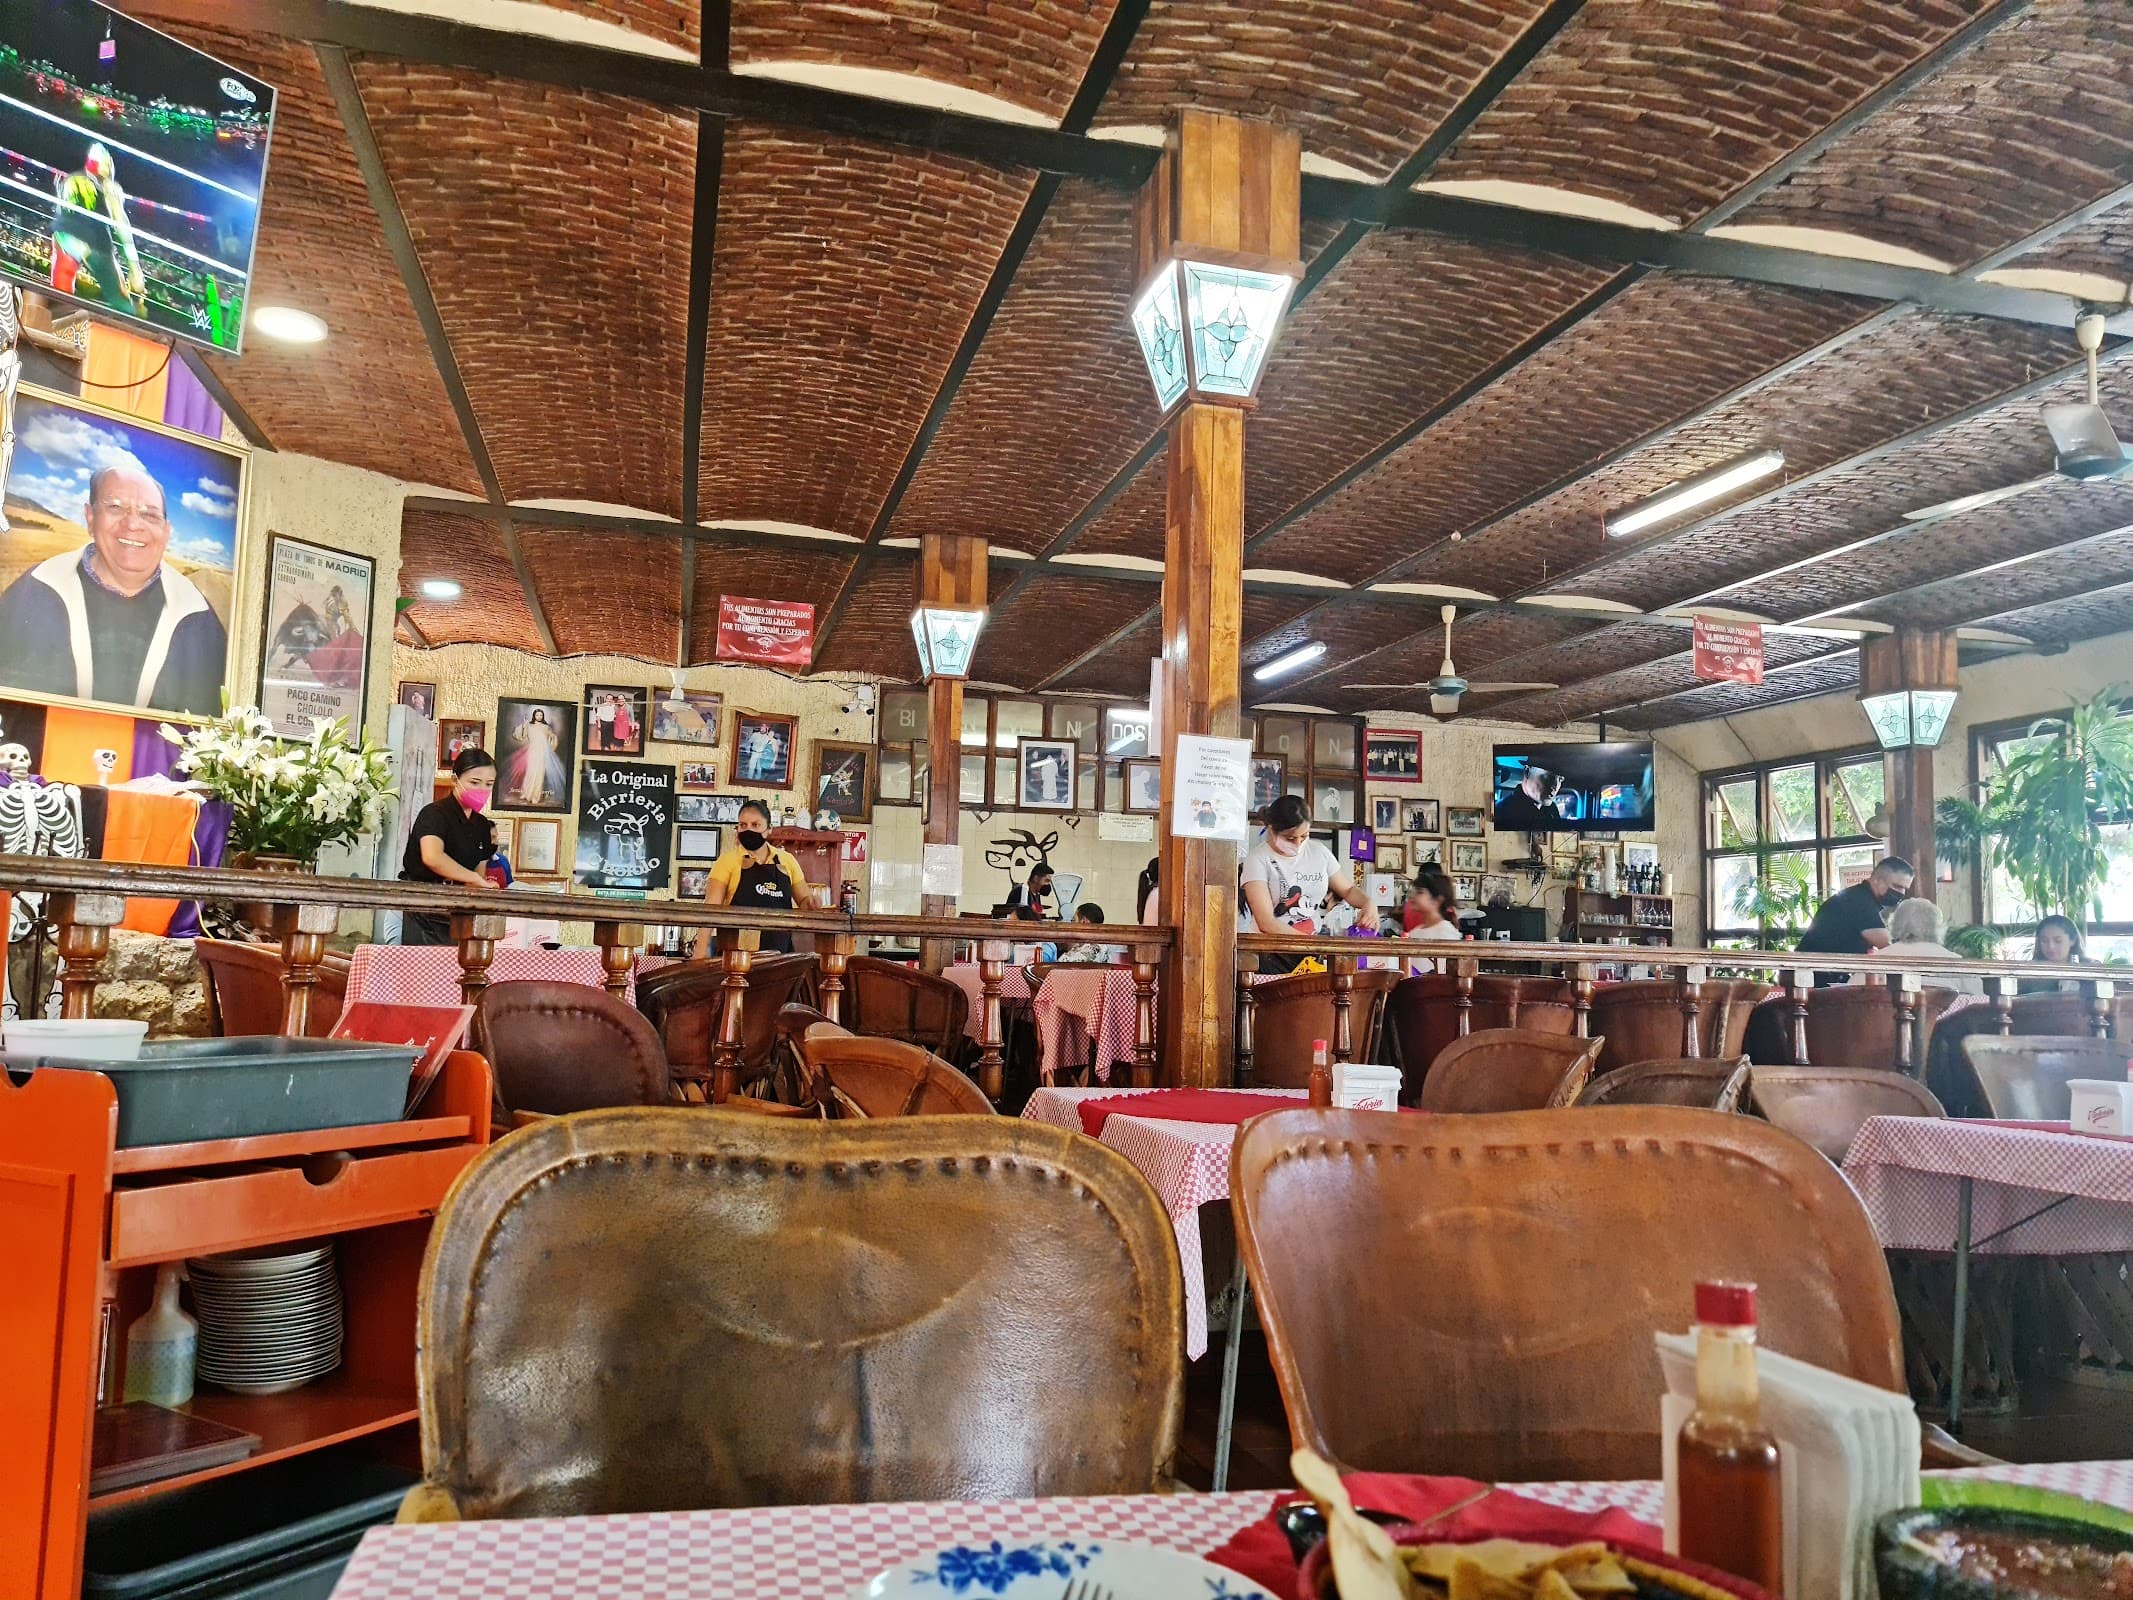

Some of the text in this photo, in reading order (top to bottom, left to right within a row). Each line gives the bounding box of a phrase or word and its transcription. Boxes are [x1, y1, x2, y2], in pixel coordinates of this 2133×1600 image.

[325, 560, 367, 579] MADRID
[723, 603, 811, 619] TUS ALIMENTOS SON PREPARADOS
[722, 622, 733, 631] POR
[734, 623, 742, 631] TU
[773, 617, 796, 627] GRACIAS
[287, 688, 341, 707] PACO CAMINO
[297, 702, 333, 717] CHOLOLO
[286, 713, 296, 724] EL
[899, 709, 915, 728] BI
[1111, 723, 1146, 742] DOS
[590, 769, 668, 790] La Original
[755, 883, 784, 898] Corona
